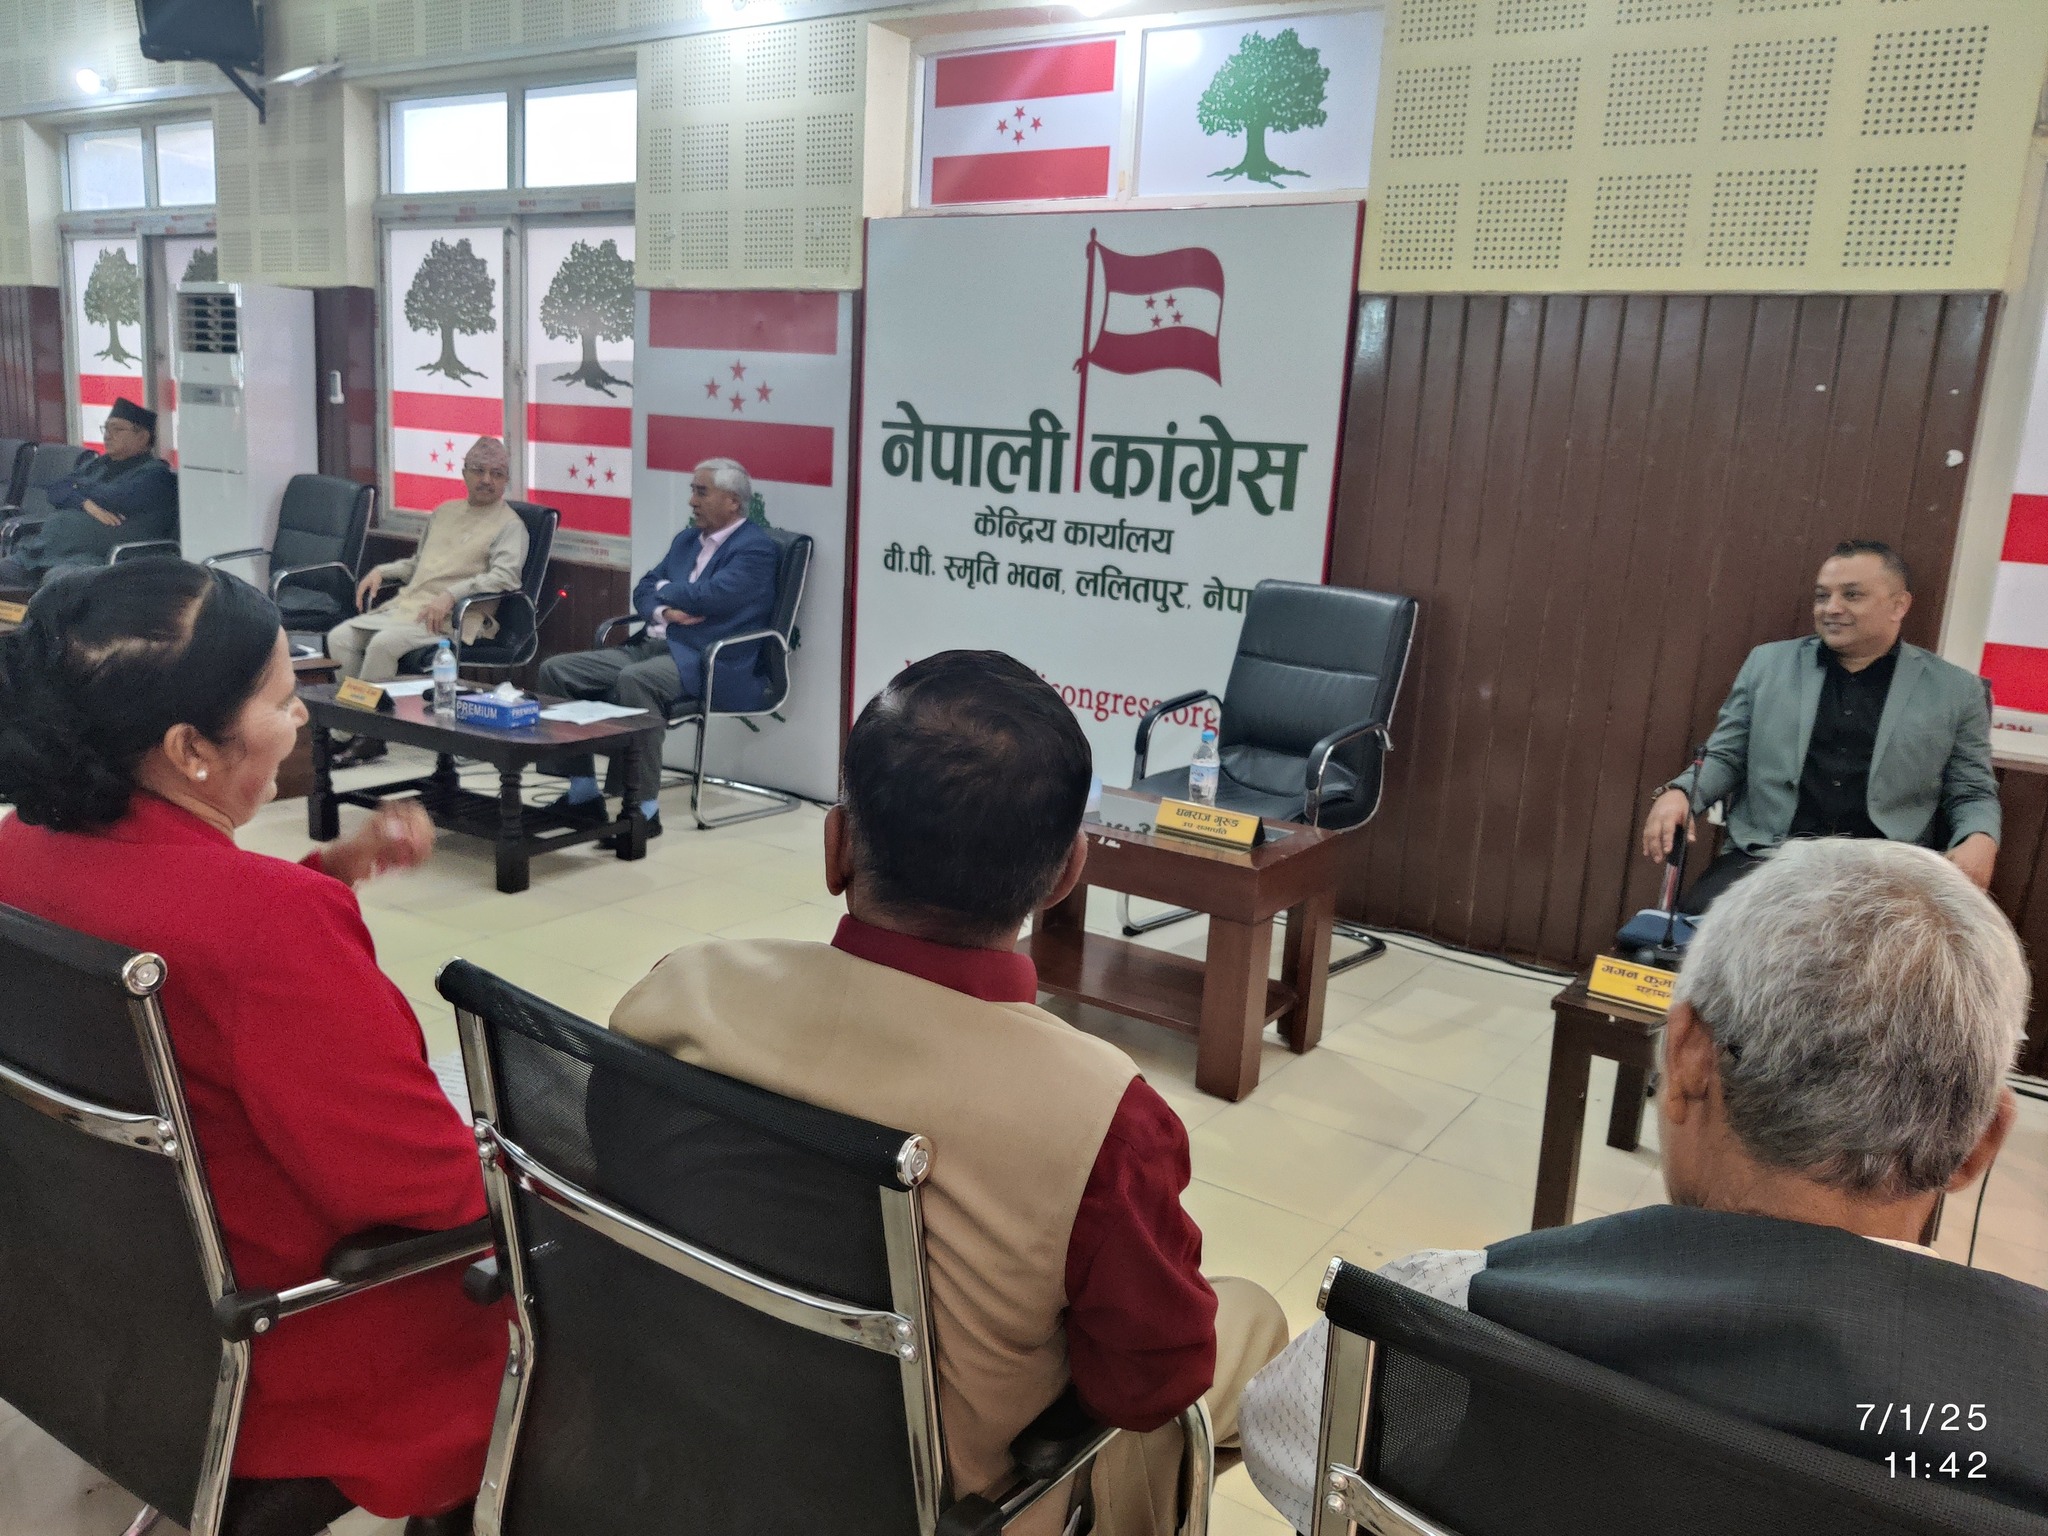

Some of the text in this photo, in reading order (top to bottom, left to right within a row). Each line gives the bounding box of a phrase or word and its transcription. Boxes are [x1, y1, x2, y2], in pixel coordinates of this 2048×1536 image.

[881, 400, 1308, 516] नेपाली कांग्रेस
[974, 504, 1175, 555] केन्द्रिय कार्यालय
[943, 550, 1000, 590] स्मृति
[1007, 562, 1066, 596] भवन,
[1075, 564, 1192, 614] ललितपुर,
[1202, 576, 1254, 614] नेपा
[456, 701, 498, 719] PREMIUM
[1644, 974, 1677, 988] कुमा
